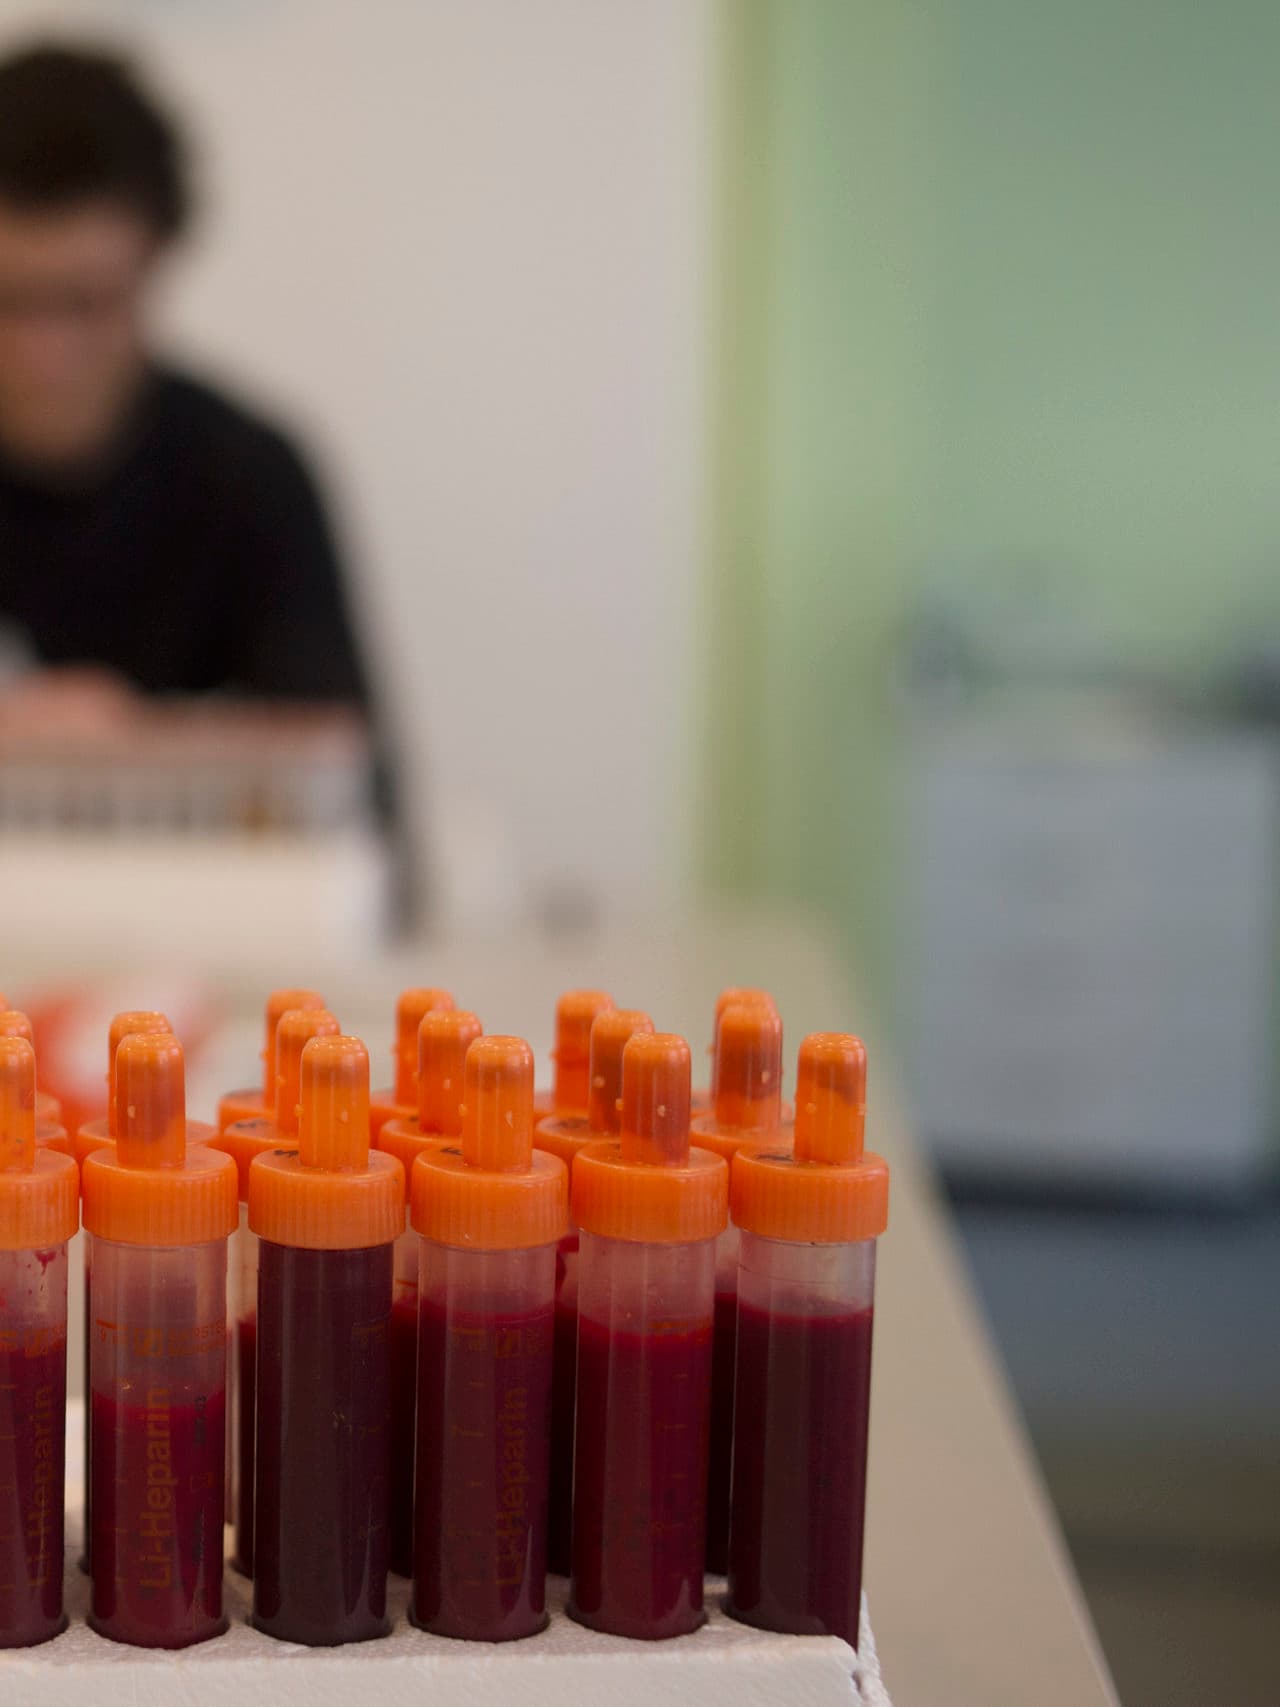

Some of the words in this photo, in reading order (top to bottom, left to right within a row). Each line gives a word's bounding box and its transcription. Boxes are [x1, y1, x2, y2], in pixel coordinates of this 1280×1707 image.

[27, 1386, 54, 1586] Li-Heparin
[138, 1388, 178, 1588] Li-Heparin
[494, 1387, 529, 1586] Li-Heparin
